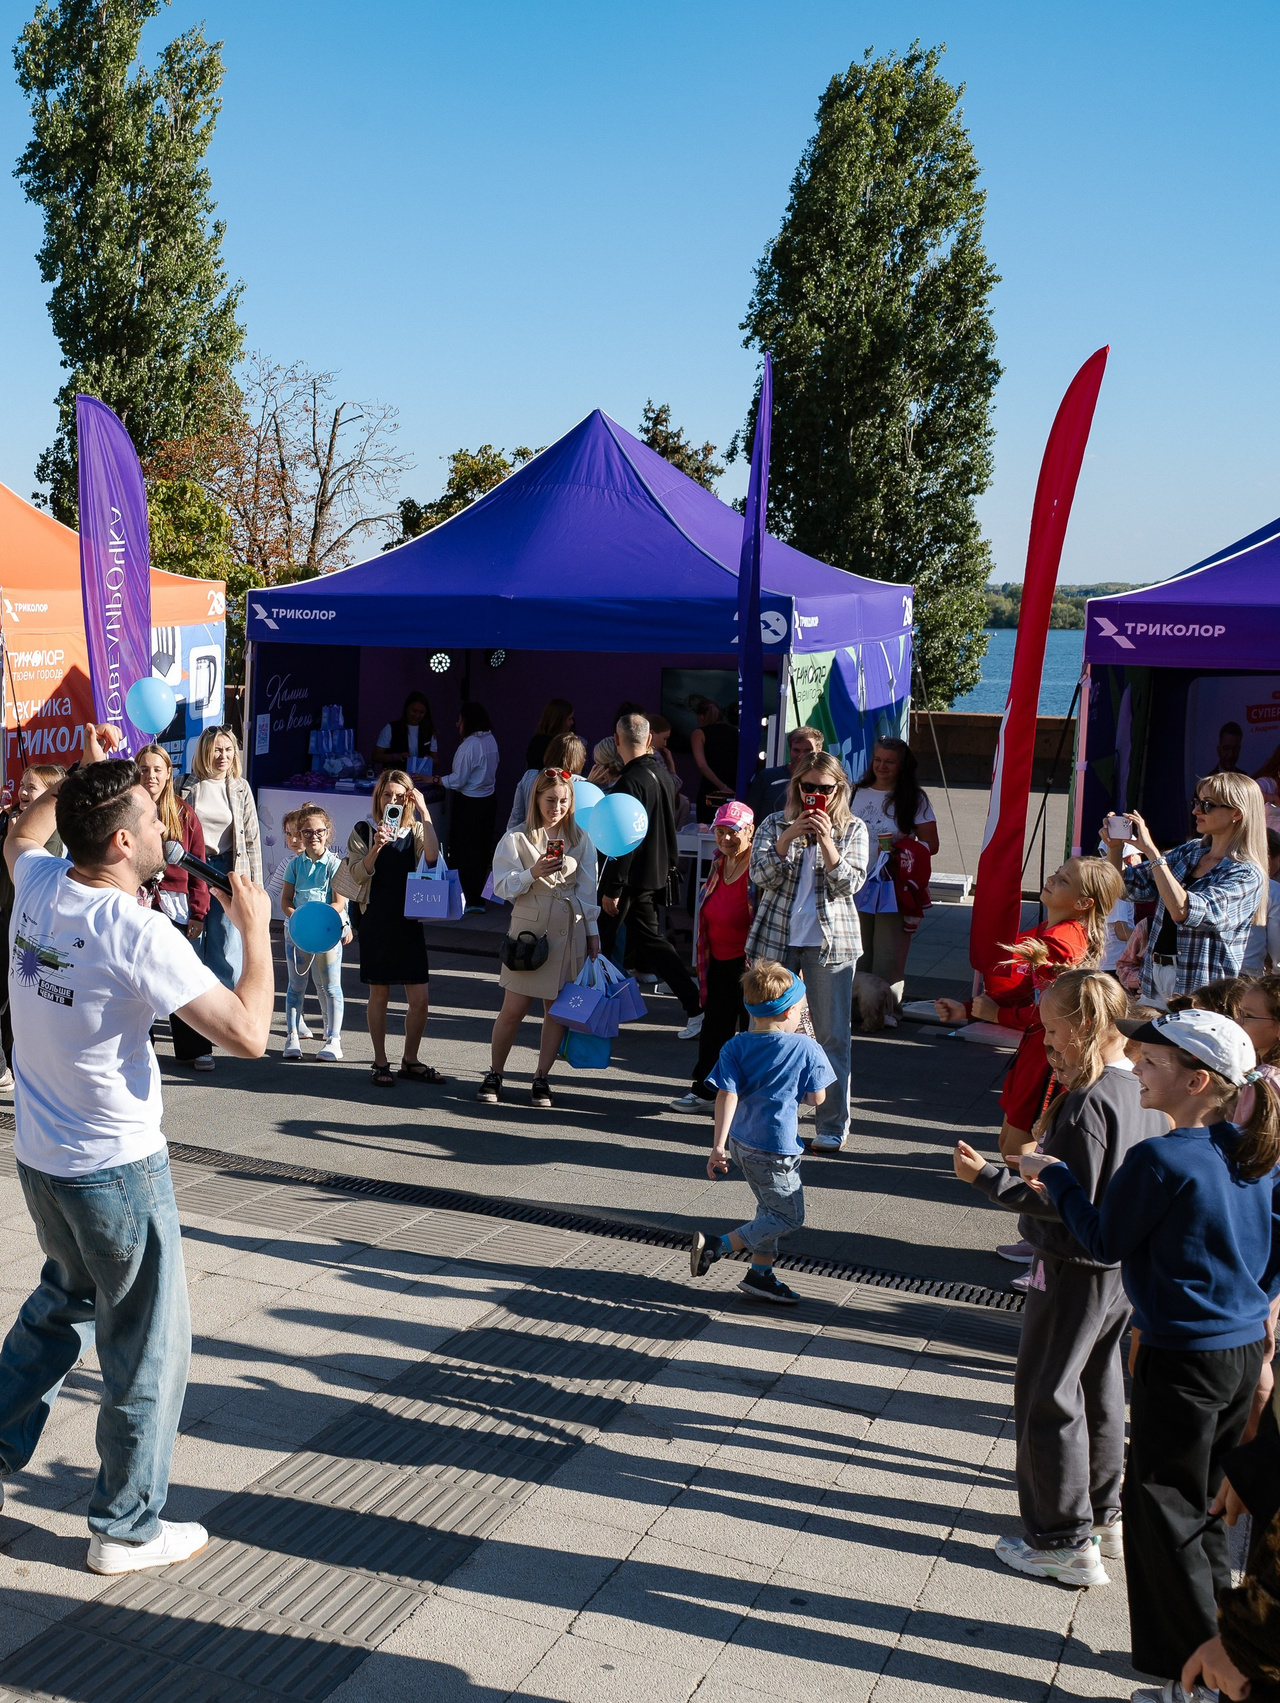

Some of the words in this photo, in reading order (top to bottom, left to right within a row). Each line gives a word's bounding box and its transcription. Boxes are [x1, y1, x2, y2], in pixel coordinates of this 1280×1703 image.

[14, 602, 48, 613] ТРИКОЛОР
[272, 608, 337, 621] ТРИКОЛОР
[1125, 622, 1226, 638] ТРИКОЛОР
[36, 668, 63, 681] городе
[426, 894, 441, 903] UVI
[40, 980, 71, 997] БОЛЬШЕ
[39, 990, 53, 1001] ЧЕМ
[55, 994, 65, 1004] ТВ
